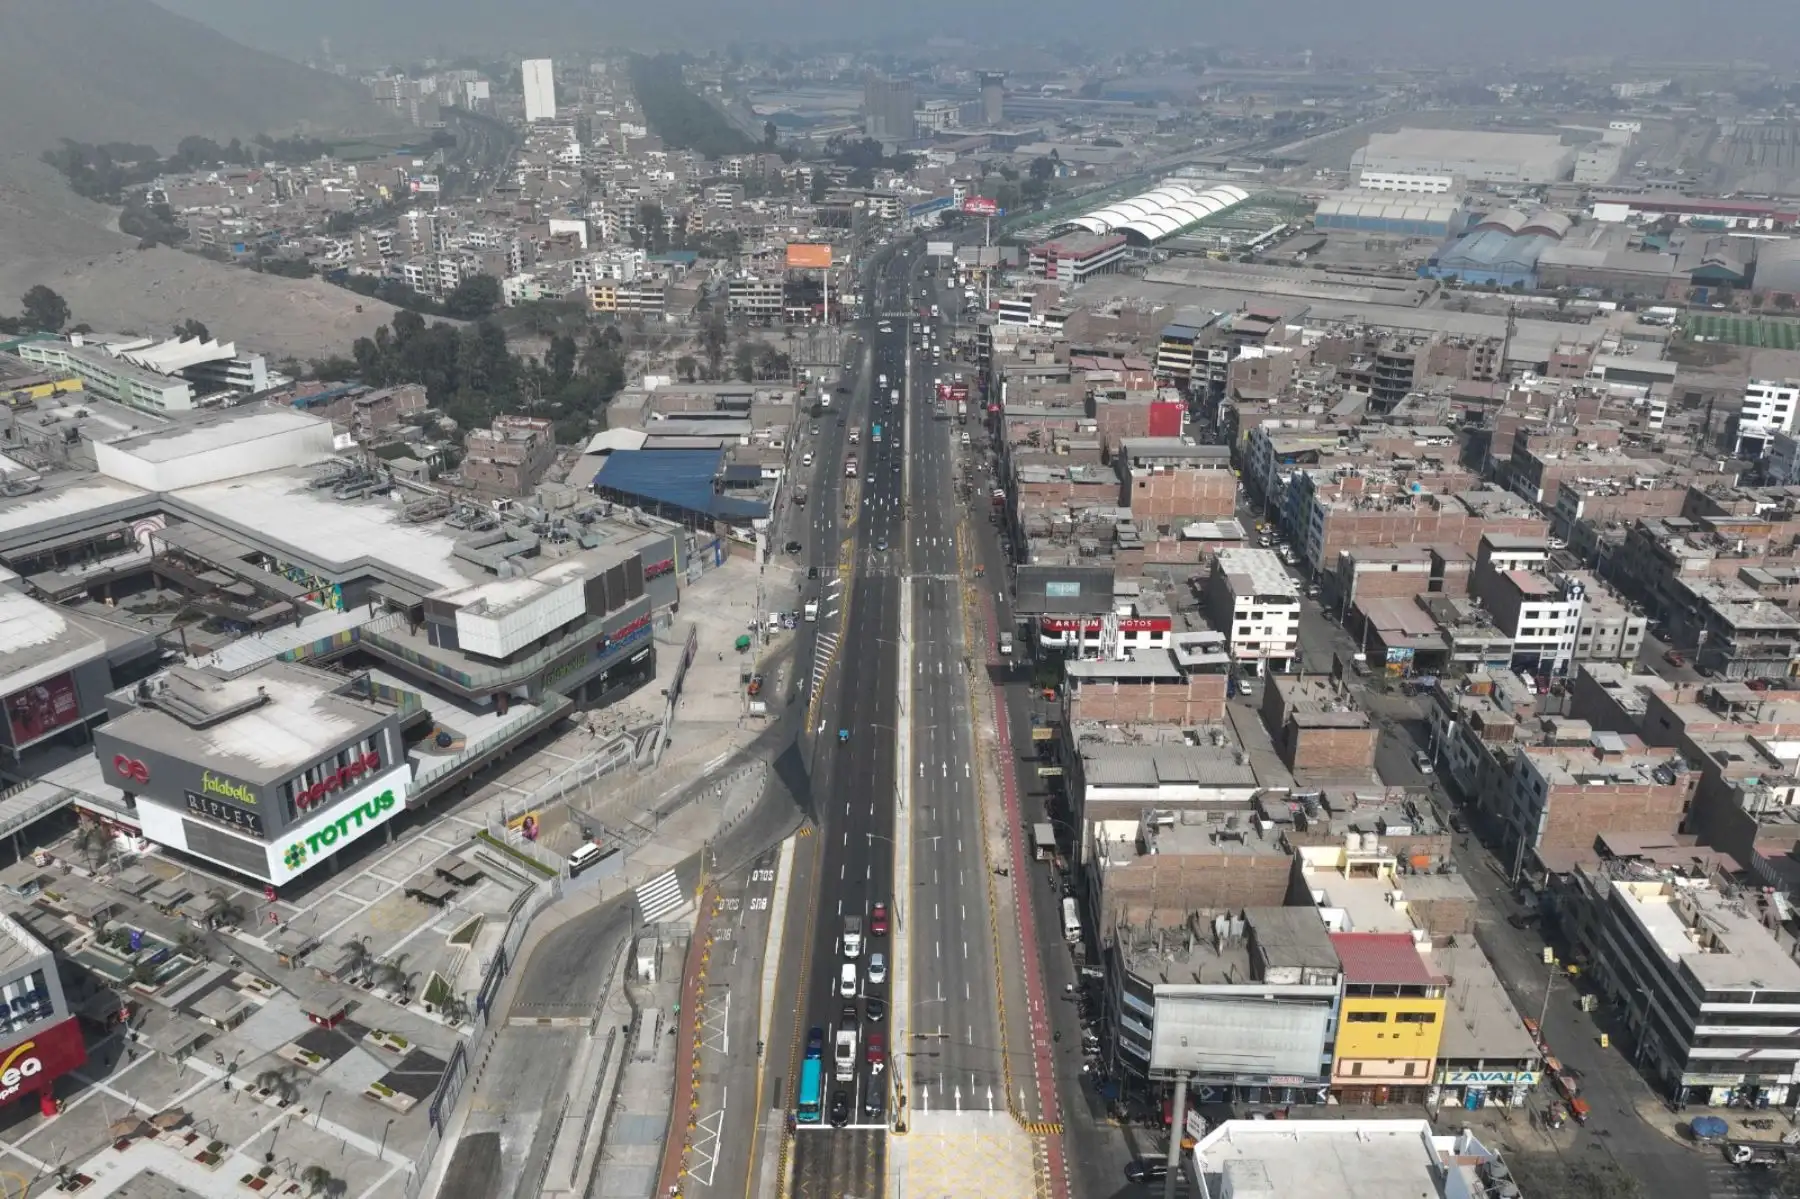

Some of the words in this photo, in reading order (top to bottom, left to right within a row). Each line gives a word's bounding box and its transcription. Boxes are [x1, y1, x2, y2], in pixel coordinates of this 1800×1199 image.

[1119, 619, 1152, 627] MOTOS
[201, 770, 257, 804] falabella
[188, 794, 256, 828] RIPLEY
[305, 788, 395, 854] TOTTUS
[752, 869, 775, 881] SOLO
[750, 897, 768, 910] BUS
[1451, 1072, 1534, 1082] ZAVALA
[0, 1083, 20, 1100] per
